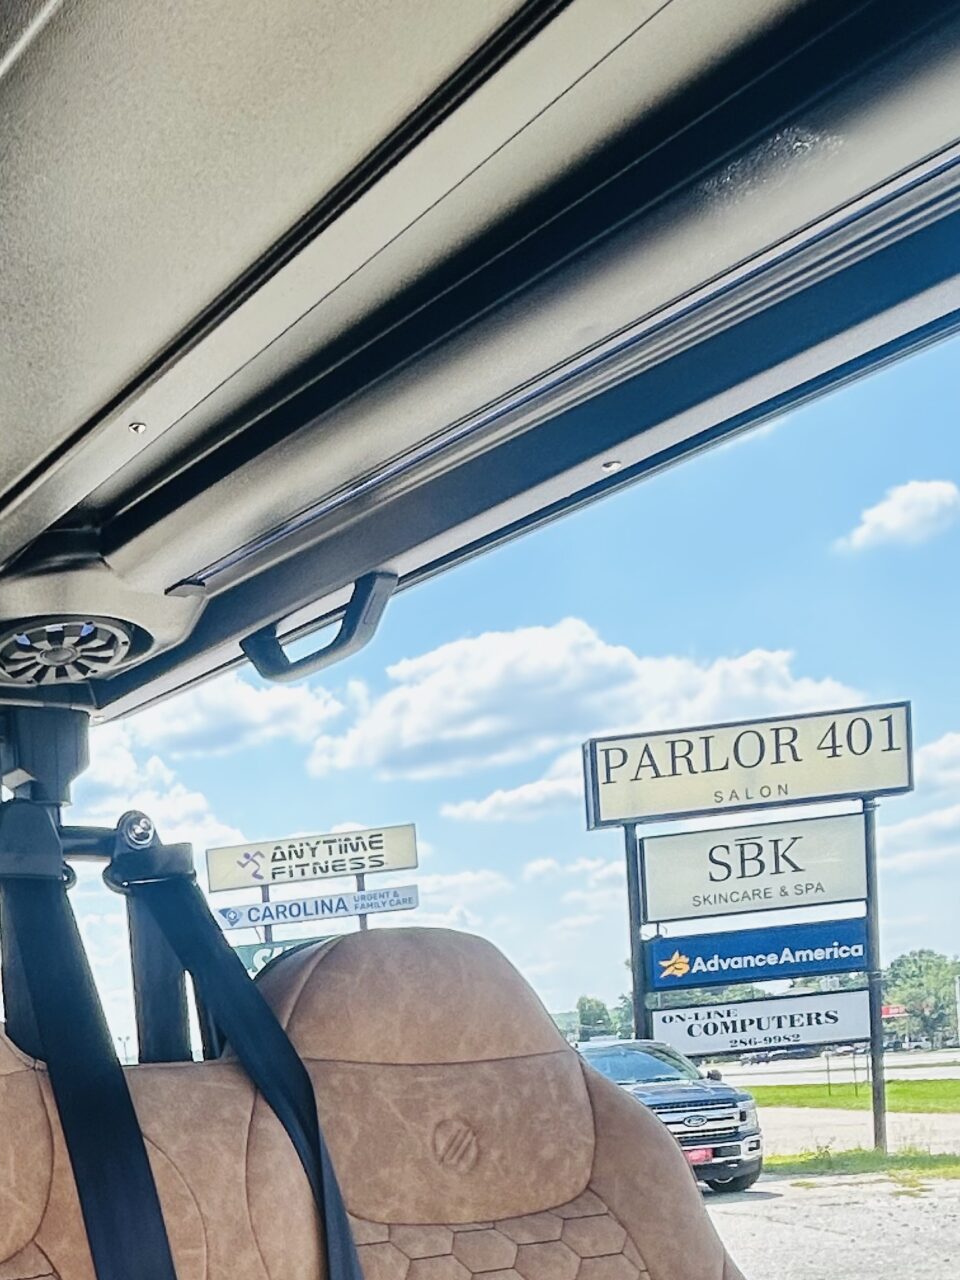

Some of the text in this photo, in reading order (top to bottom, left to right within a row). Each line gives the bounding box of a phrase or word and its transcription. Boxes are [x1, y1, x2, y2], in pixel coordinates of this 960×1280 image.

[599, 714, 902, 785] PARLOR 401
[713, 783, 790, 804] SALON
[270, 833, 384, 863] ANYTIME
[708, 836, 806, 883] SBK
[271, 854, 386, 881] FITNESS
[353, 890, 400, 903] URGENT &
[354, 896, 414, 911] FAMILY CARE
[692, 881, 825, 907] SKINCARE & SPA
[247, 897, 349, 923] CAROLINA
[661, 1008, 738, 1025] ON-LINE
[687, 1010, 839, 1038] COMPUTERS
[729, 1034, 801, 1048] 286-9982
